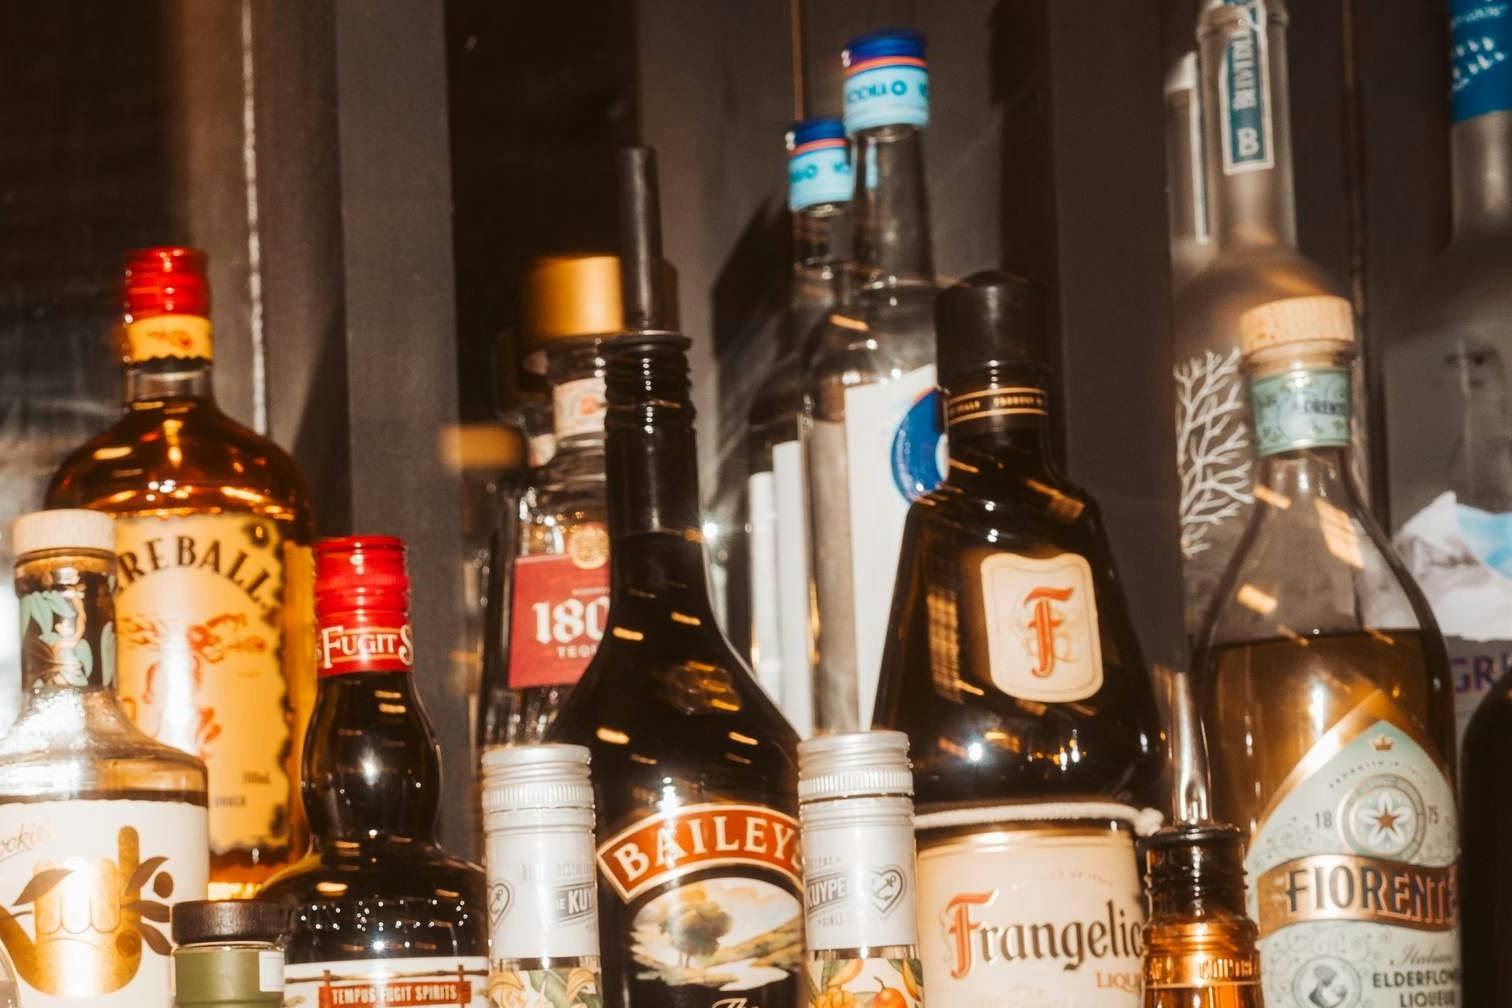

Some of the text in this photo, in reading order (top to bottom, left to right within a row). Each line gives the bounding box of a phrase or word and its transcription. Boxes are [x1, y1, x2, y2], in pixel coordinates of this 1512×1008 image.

[117, 535, 274, 605] REBALL
[531, 595, 611, 645] 180
[321, 625, 399, 670] FUGIT
[942, 887, 1145, 980] Frangelic
[332, 984, 377, 1006] TEMPUS
[415, 983, 458, 1002] SPIRITS
